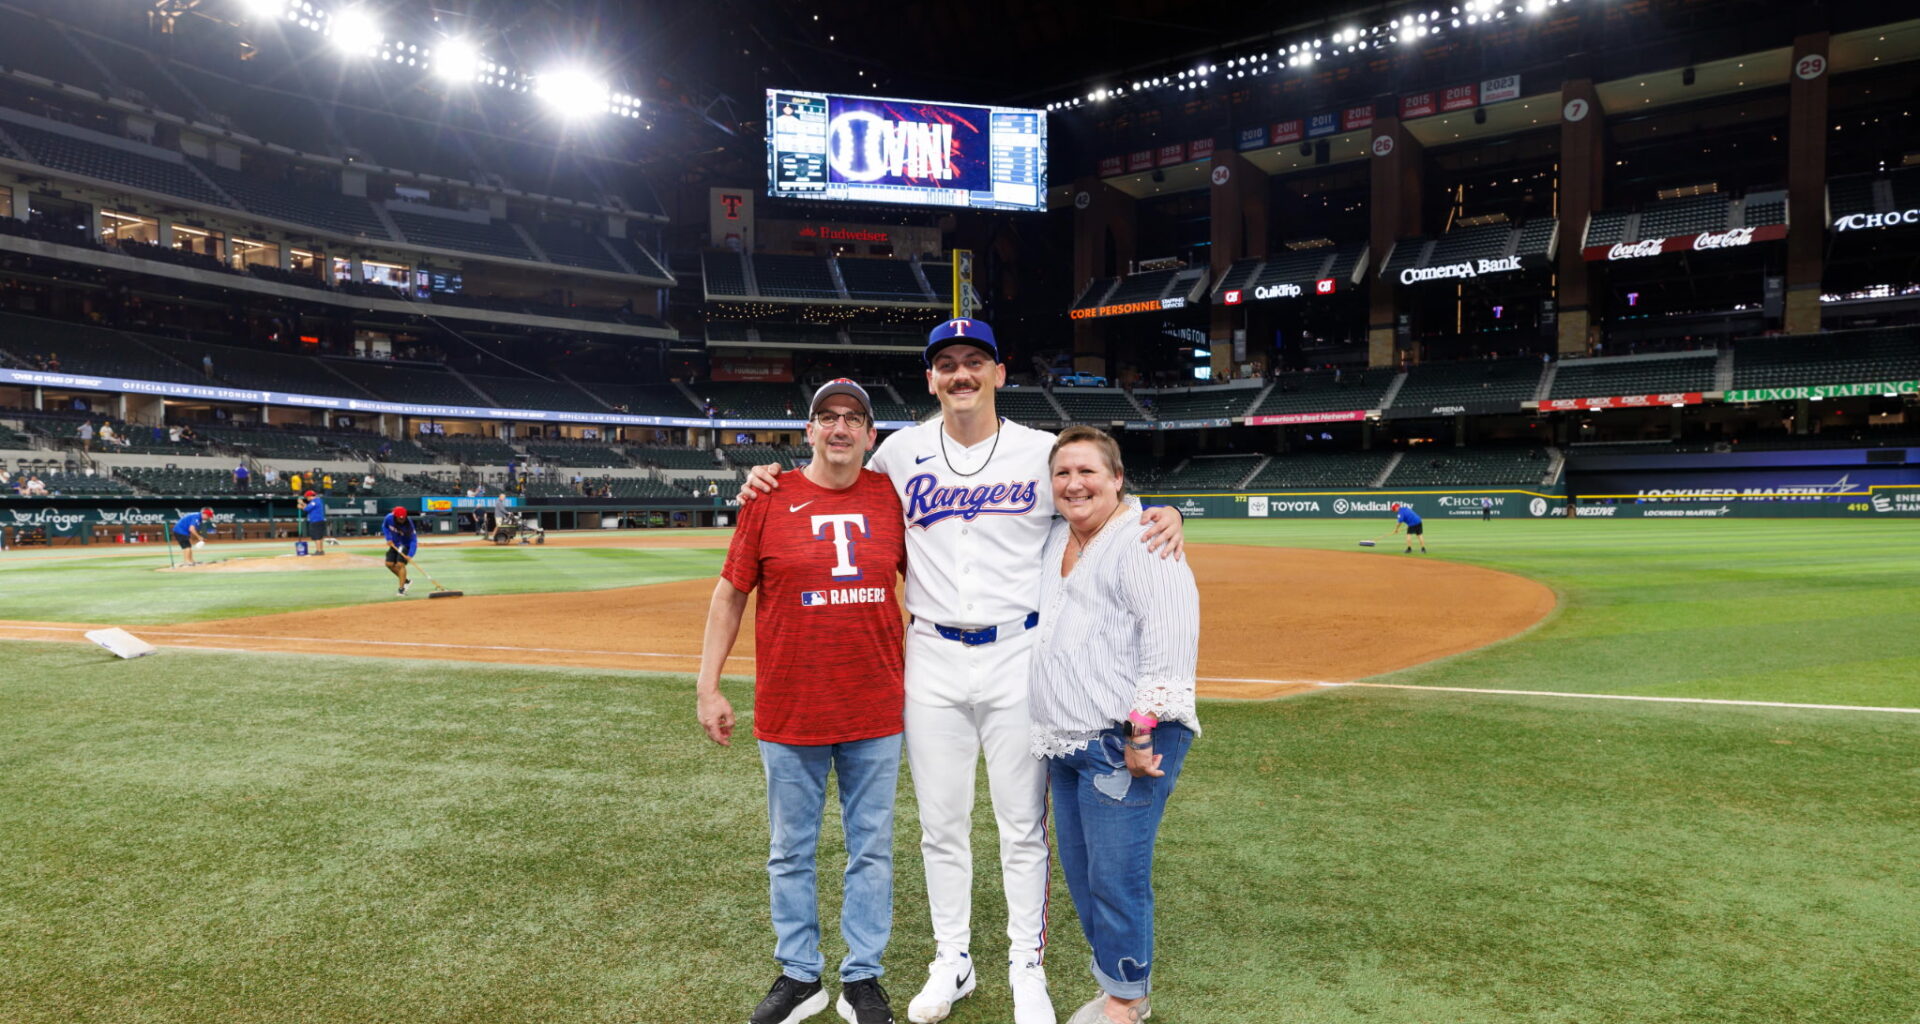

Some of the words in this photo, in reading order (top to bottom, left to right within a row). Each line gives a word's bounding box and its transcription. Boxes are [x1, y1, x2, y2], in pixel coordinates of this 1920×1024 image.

[1799, 59, 1822, 75] 29
[1486, 77, 1514, 92] 2023
[1446, 86, 1471, 100] 2016
[1405, 96, 1430, 108] 2015
[1348, 106, 1372, 120] 2012
[1571, 103, 1581, 117] 7
[1277, 120, 1297, 133] 2011
[1312, 114, 1333, 127] 2011
[1242, 127, 1263, 140] 2010
[1375, 138, 1391, 151] 26
[1214, 170, 1228, 181] 34
[1077, 195, 1088, 206] 42
[1846, 209, 1920, 230] CHOC
[820, 227, 888, 242] Budweiser
[1694, 228, 1756, 251] Coca-Cola
[1608, 238, 1665, 260] Coca-Cola
[1477, 256, 1522, 274] Bank
[1255, 284, 1301, 299] QuikTrip
[1318, 280, 1333, 292] QT
[1161, 297, 1184, 305] STAFFING
[1225, 292, 1239, 303] QT
[1070, 308, 1097, 320] CORE
[1099, 301, 1162, 317] PERSONNEL
[1162, 301, 1184, 309] SERVICES
[950, 318, 972, 337] T
[122, 382, 166, 392] OFFICIAL
[171, 384, 189, 393] LAW
[193, 387, 214, 396] FIRM
[218, 389, 258, 399] SPONSOR
[1743, 385, 1809, 401] LUXOR
[1813, 381, 1914, 398] STAFFING
[1551, 399, 1577, 407] DEX
[1586, 397, 1611, 405] DEX
[1621, 396, 1647, 404] DEX
[1657, 393, 1685, 402] DEX
[1432, 405, 1465, 414] ARENA
[1302, 413, 1320, 421] Best
[1321, 412, 1355, 421] Network
[1637, 488, 1738, 502] LOCKHEED
[1741, 487, 1824, 502] MARTIN
[905, 472, 1039, 532] Rangers
[1270, 501, 1320, 511] TOYOTA
[1351, 501, 1391, 511] Medical
[1847, 503, 1869, 511] 410
[1551, 507, 1617, 517] PRRESSIVE
[35, 508, 86, 531] Kroger
[811, 514, 871, 582] T
[830, 588, 886, 605] RANGERS
